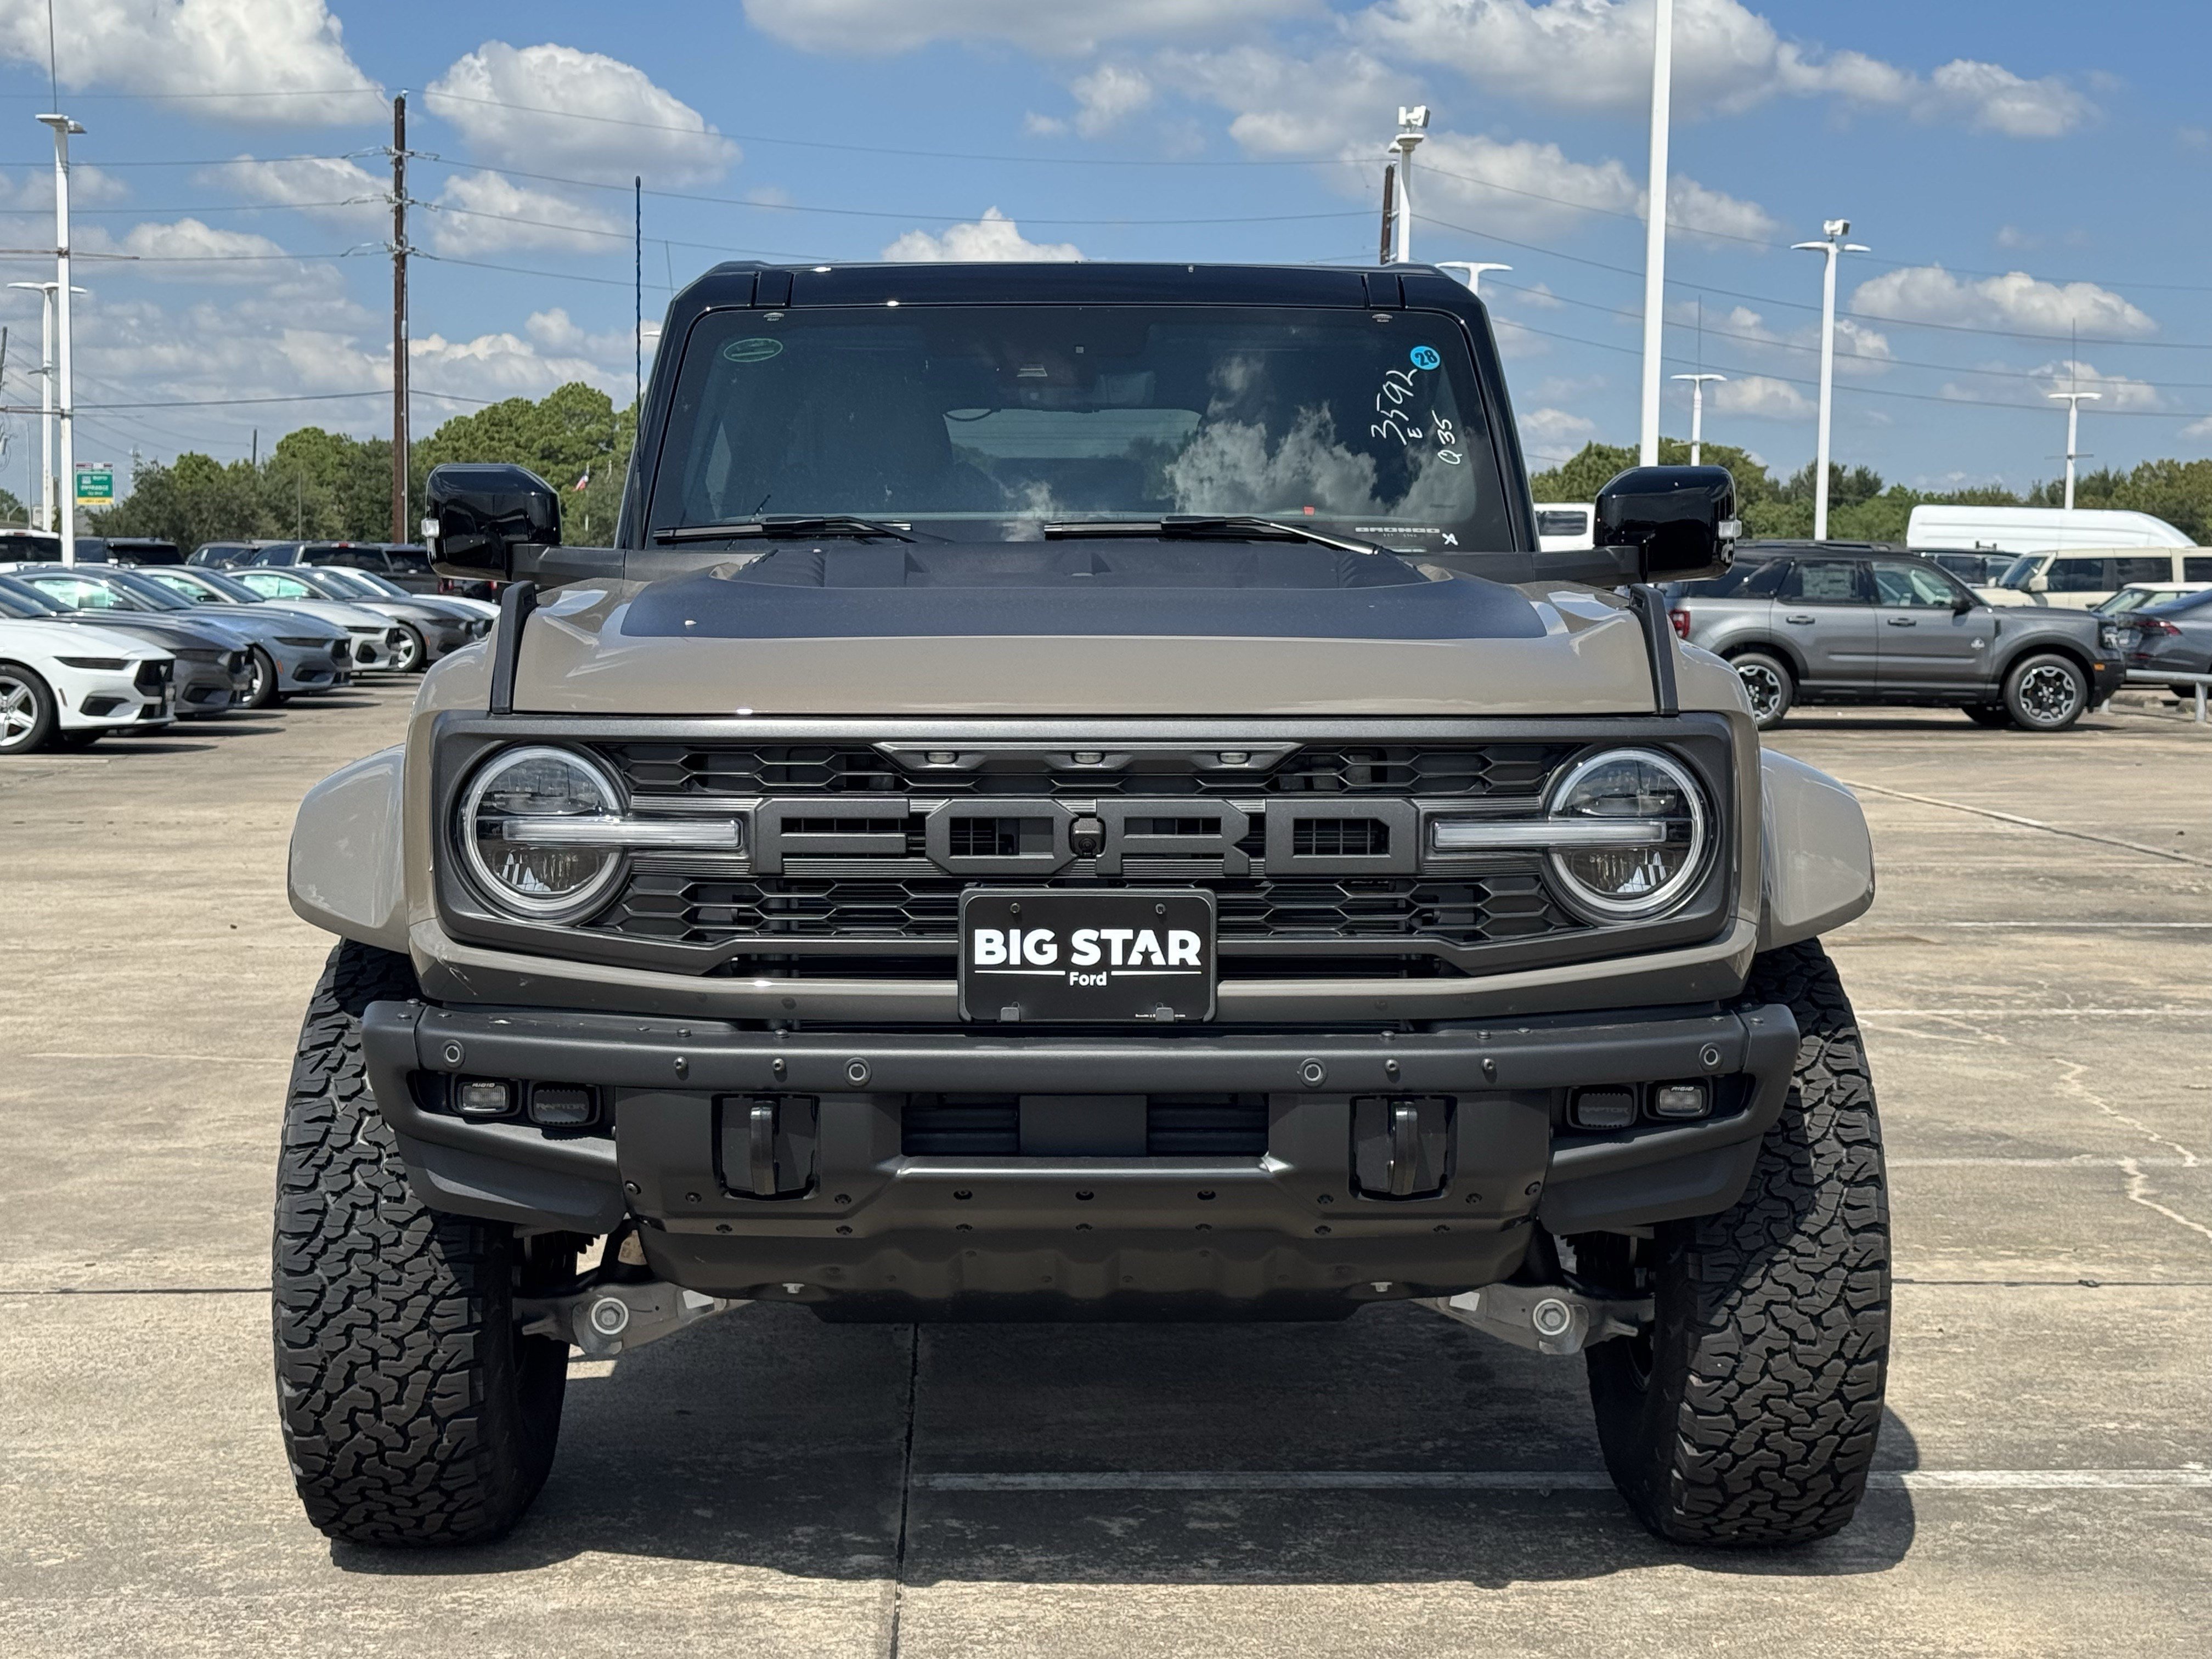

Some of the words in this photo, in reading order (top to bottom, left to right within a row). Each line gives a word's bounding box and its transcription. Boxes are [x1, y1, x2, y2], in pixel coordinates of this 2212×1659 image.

[1414, 349, 1438, 366] 28
[757, 798, 1418, 875] FORD
[974, 929, 1058, 966] BIG
[1070, 929, 1202, 966] STAR
[1069, 971, 1108, 987] Ford
[1580, 1106, 1630, 1115] RAPTOR
